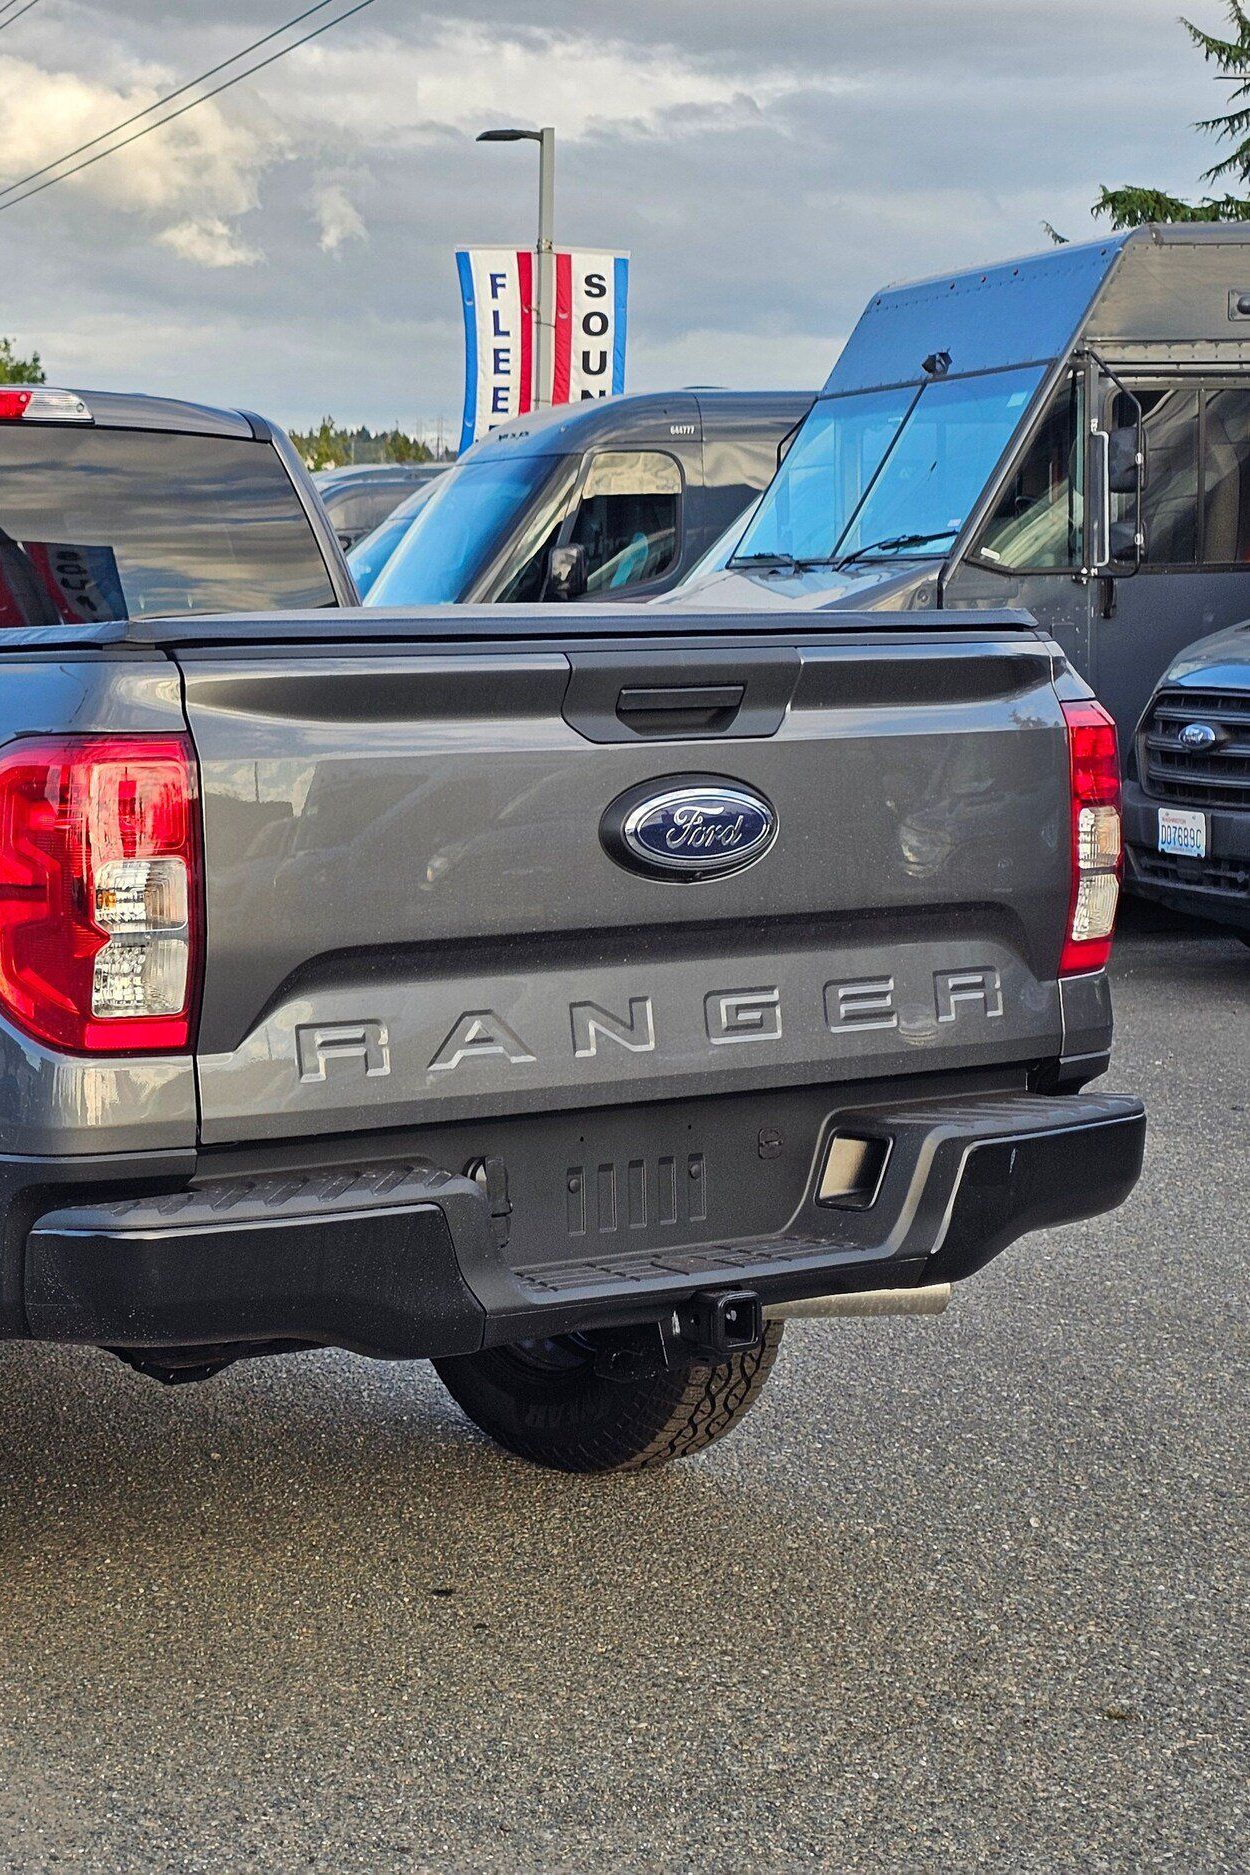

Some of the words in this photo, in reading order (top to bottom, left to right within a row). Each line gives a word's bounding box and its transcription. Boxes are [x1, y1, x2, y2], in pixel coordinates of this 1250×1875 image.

[489, 273, 511, 431] FLEE
[665, 805, 744, 849] Ford
[296, 965, 1003, 1084] RANGER
